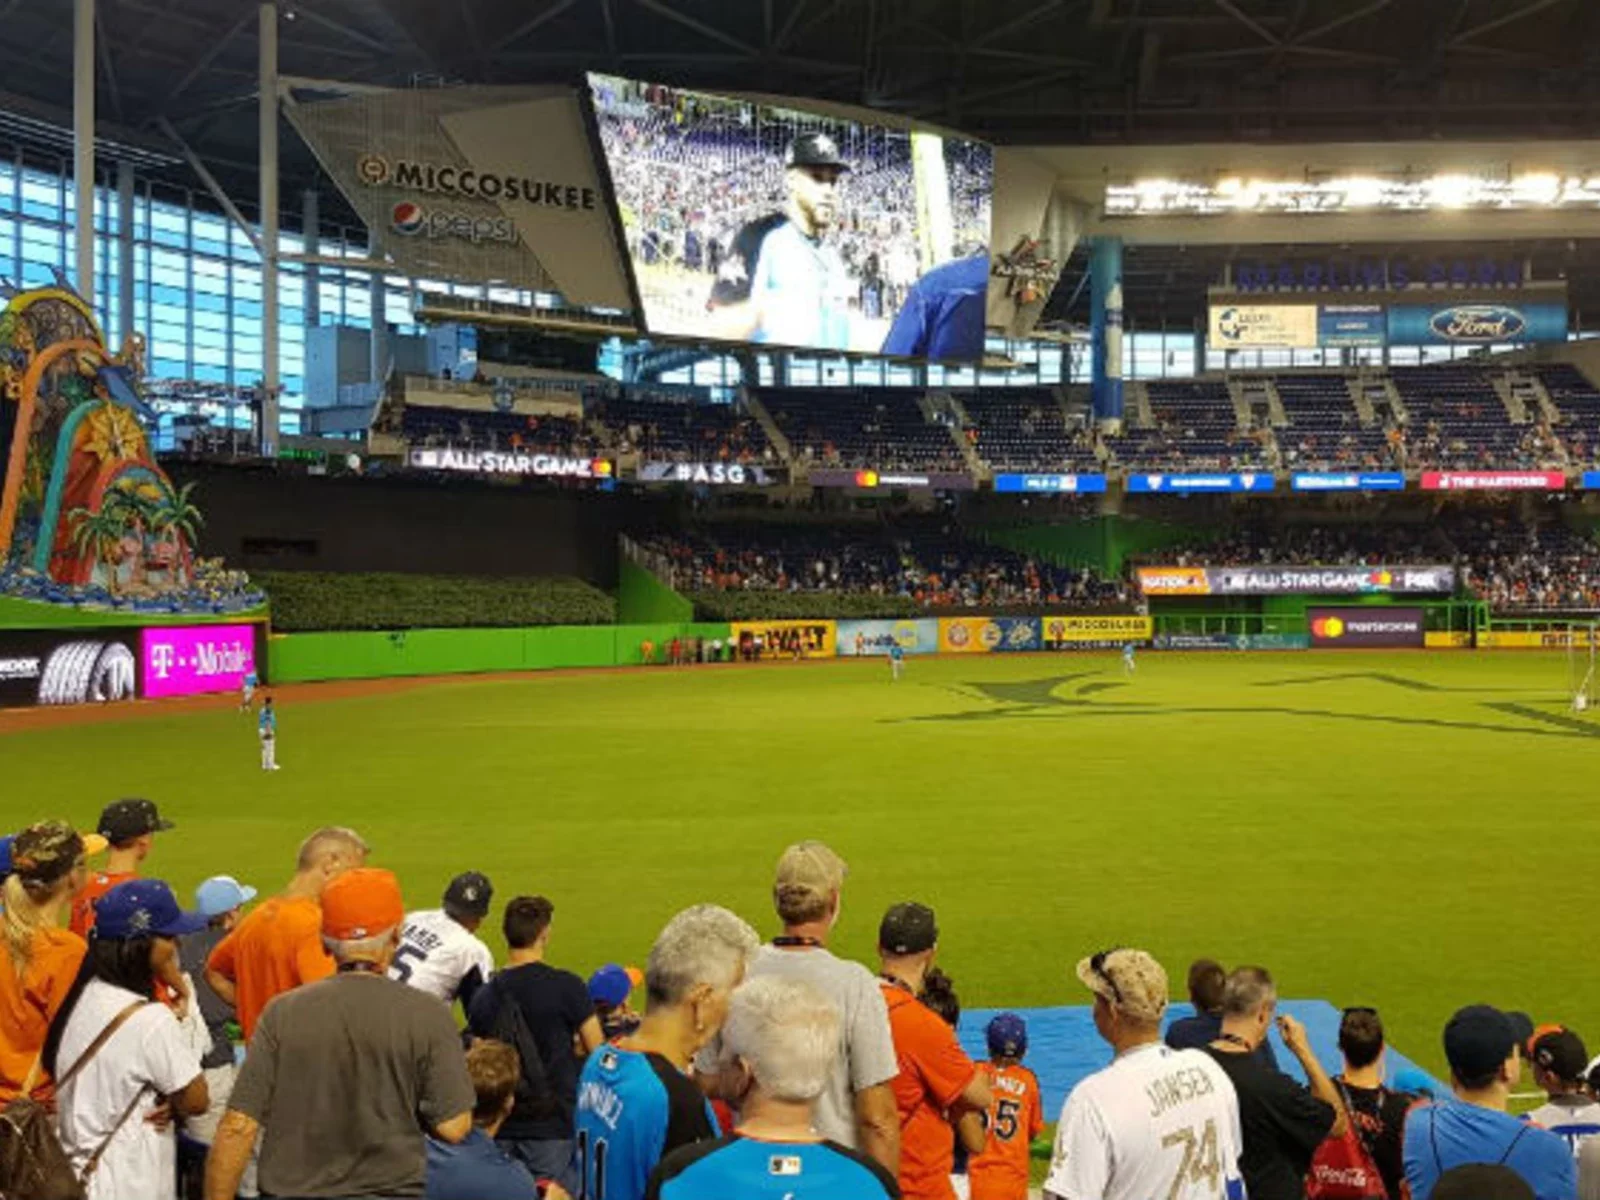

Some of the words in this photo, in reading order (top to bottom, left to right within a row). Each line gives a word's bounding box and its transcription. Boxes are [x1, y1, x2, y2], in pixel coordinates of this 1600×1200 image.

[396, 162, 595, 211] MICCOSUKEE
[427, 210, 517, 243] pepsi
[1446, 312, 1506, 336] Ford
[532, 455, 592, 477] GAME
[1320, 571, 1372, 589] GAME
[1147, 1064, 1215, 1118] JANSEN
[1161, 1117, 1221, 1200] 74
